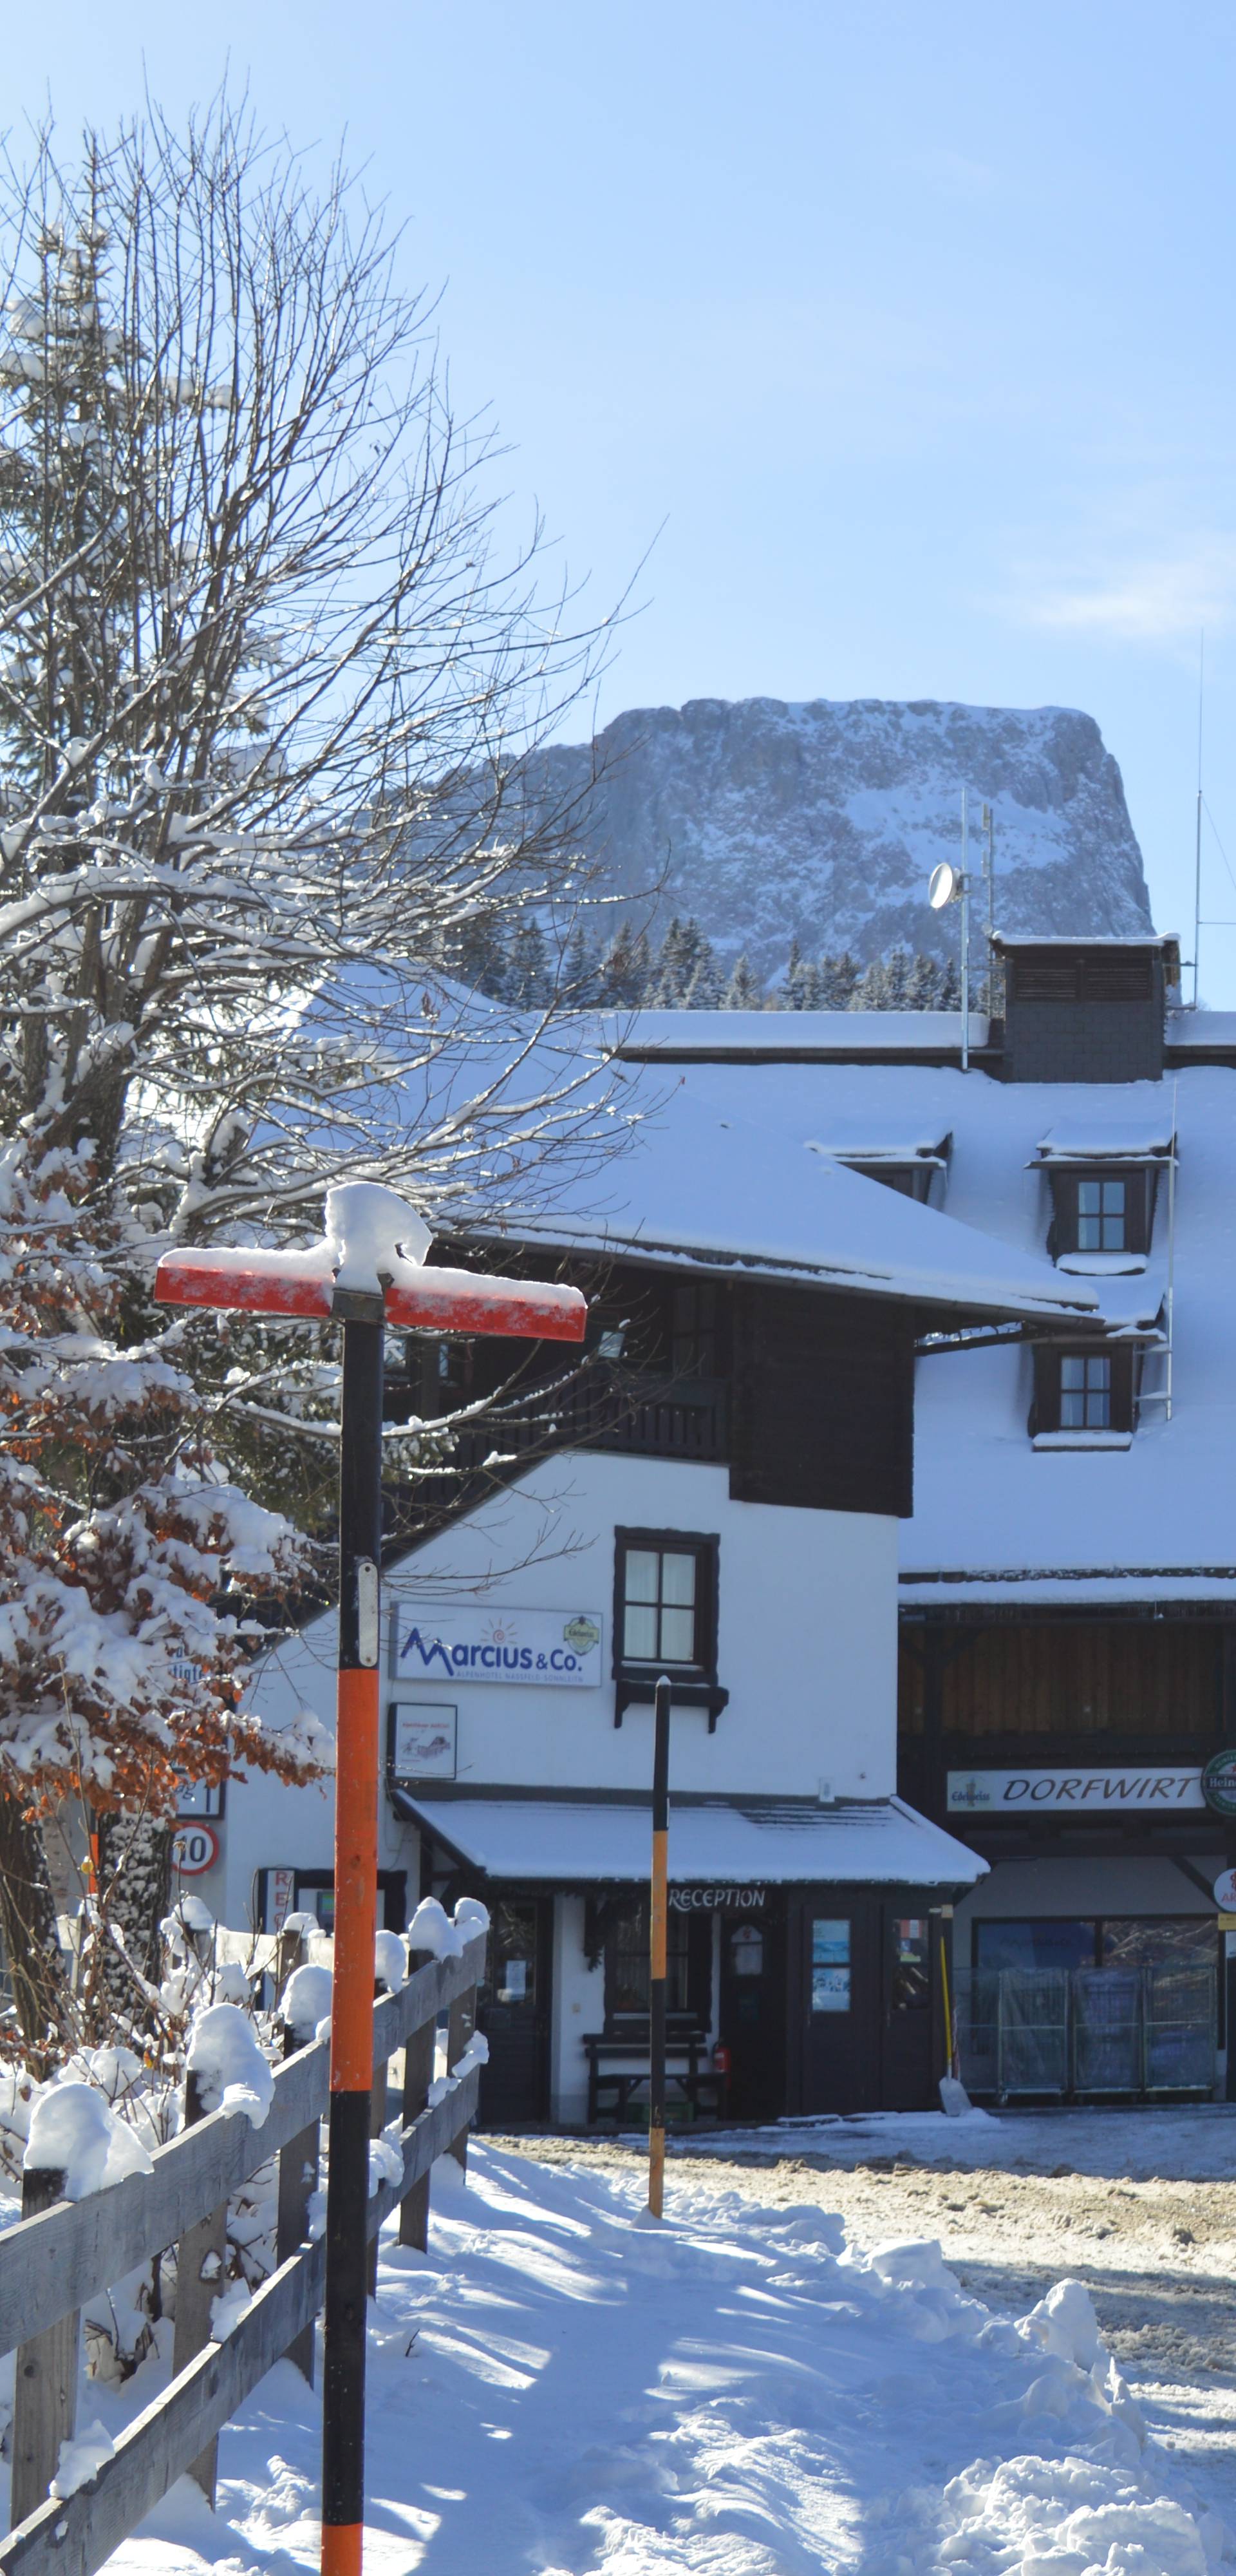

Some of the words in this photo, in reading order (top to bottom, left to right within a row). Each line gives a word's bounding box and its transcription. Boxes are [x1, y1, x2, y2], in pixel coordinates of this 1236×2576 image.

[400, 1627, 532, 1676] Marcius
[550, 1649, 583, 1672] Co.
[1003, 1776, 1200, 1801] DORFWIRT
[177, 1835, 206, 1862] 10
[668, 1888, 766, 1912] RECEPTION
